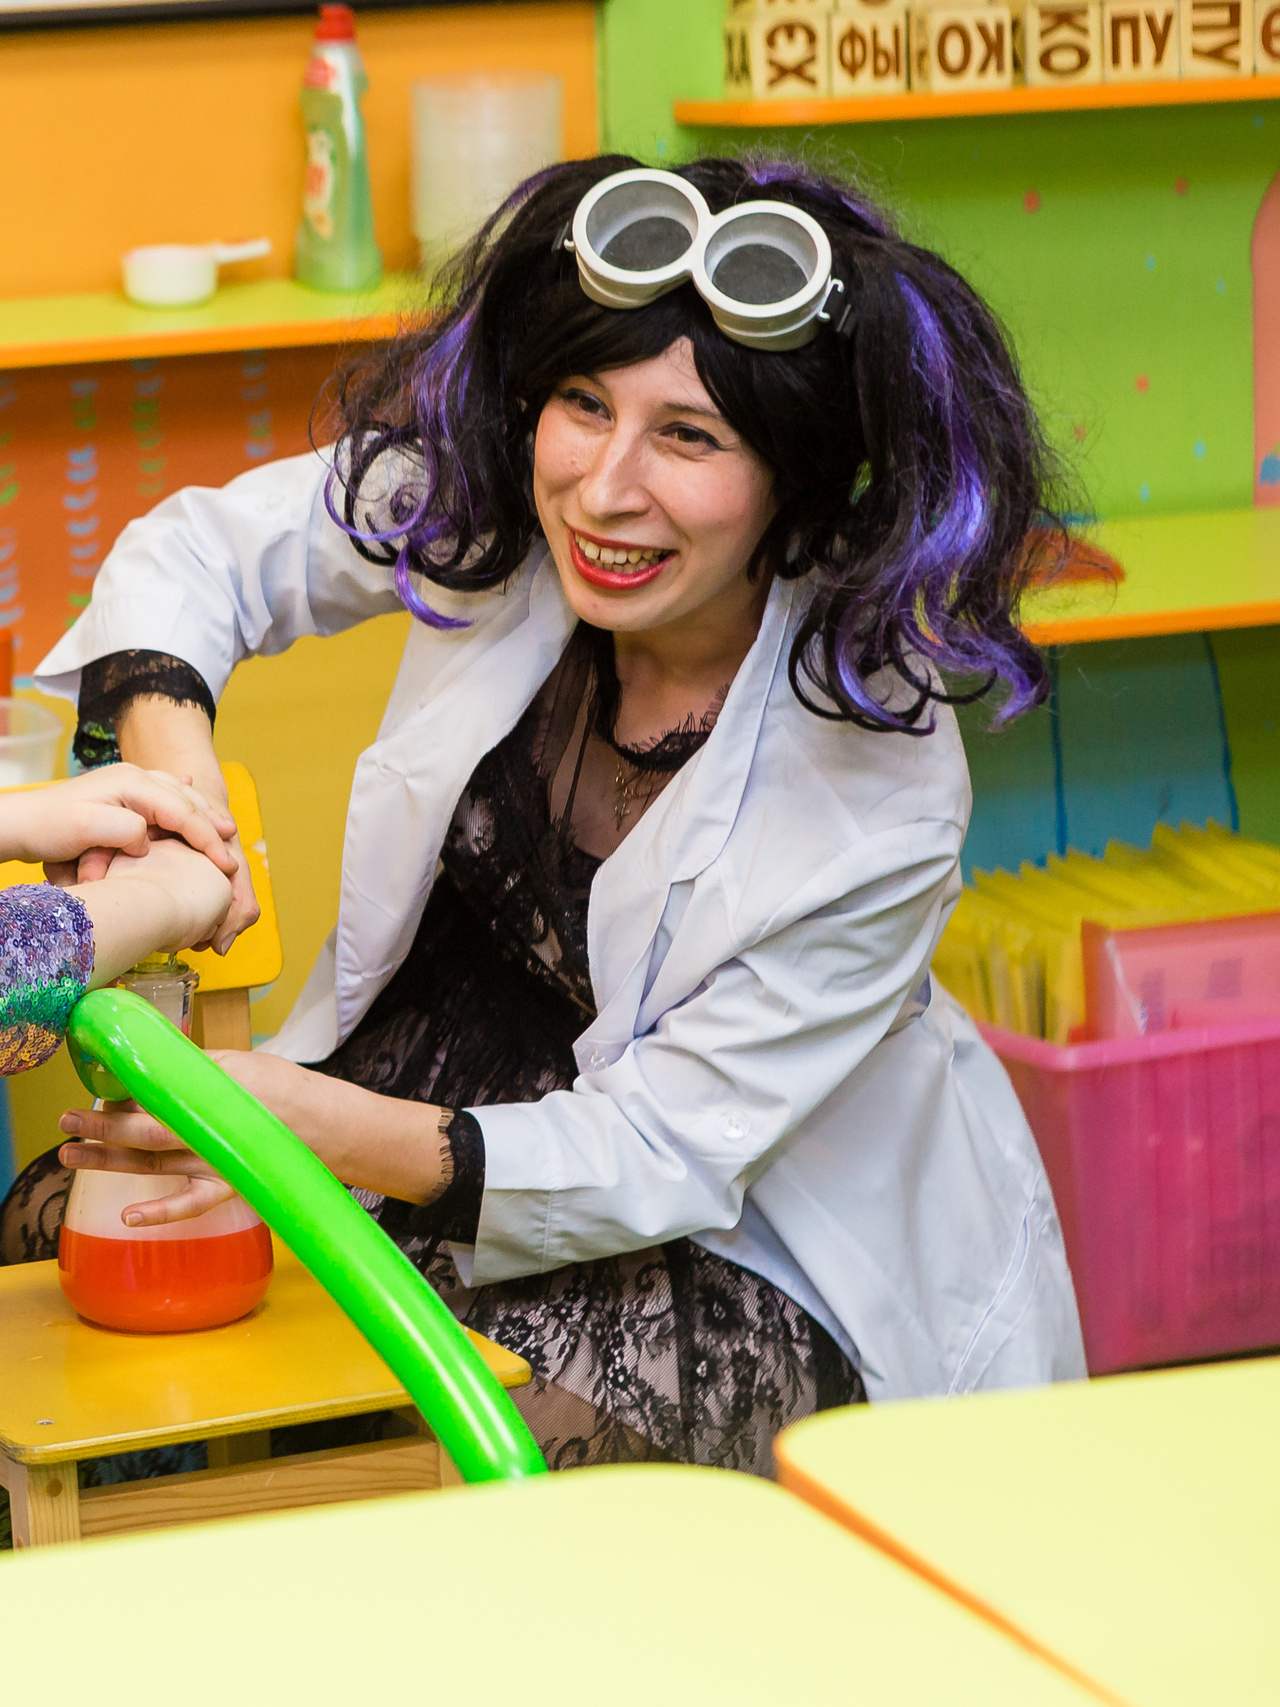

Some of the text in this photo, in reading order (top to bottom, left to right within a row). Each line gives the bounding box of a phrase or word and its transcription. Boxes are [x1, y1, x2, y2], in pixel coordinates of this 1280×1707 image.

[838, 25, 901, 81] ФЫ
[1038, 6, 1090, 76] КО
[1111, 12, 1173, 67] ПУ
